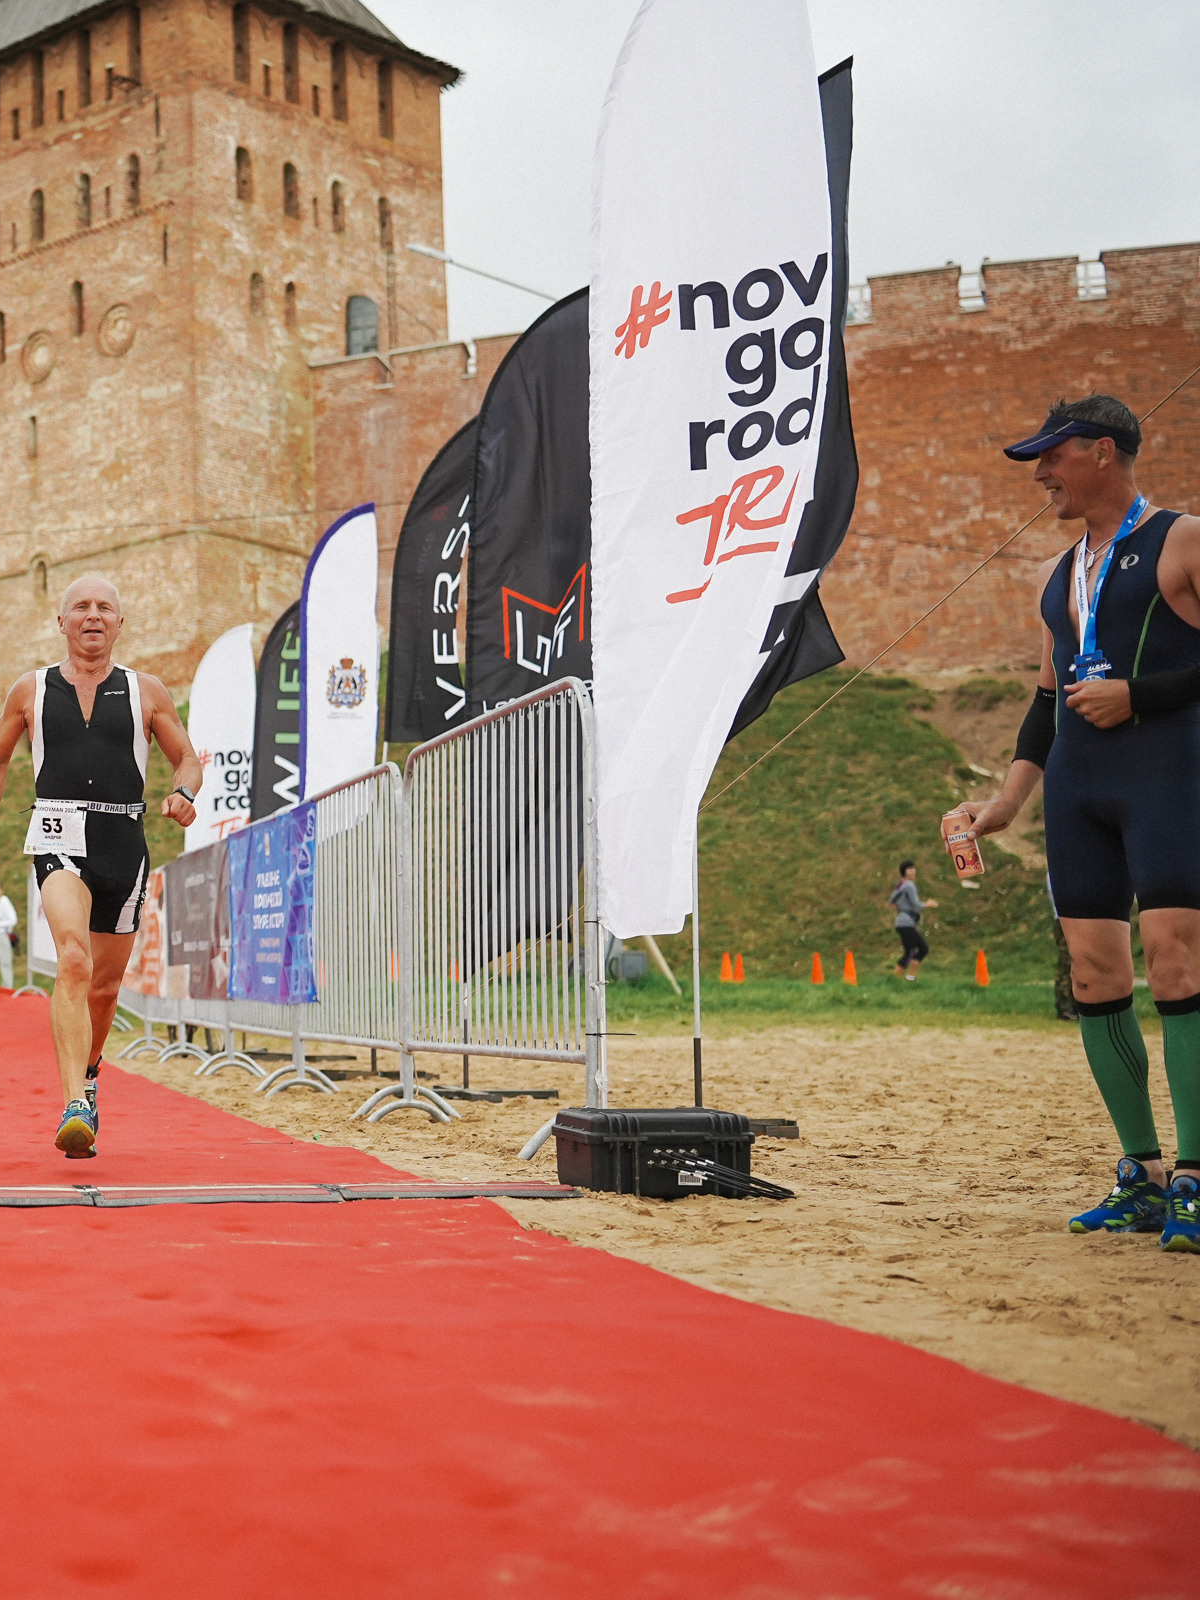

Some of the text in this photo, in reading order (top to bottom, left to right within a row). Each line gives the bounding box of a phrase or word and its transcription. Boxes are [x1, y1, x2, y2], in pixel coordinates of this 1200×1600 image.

[615, 252, 828, 359] #nov
[726, 317, 825, 407] go
[689, 364, 821, 470] rod
[42, 817, 63, 834] 53
